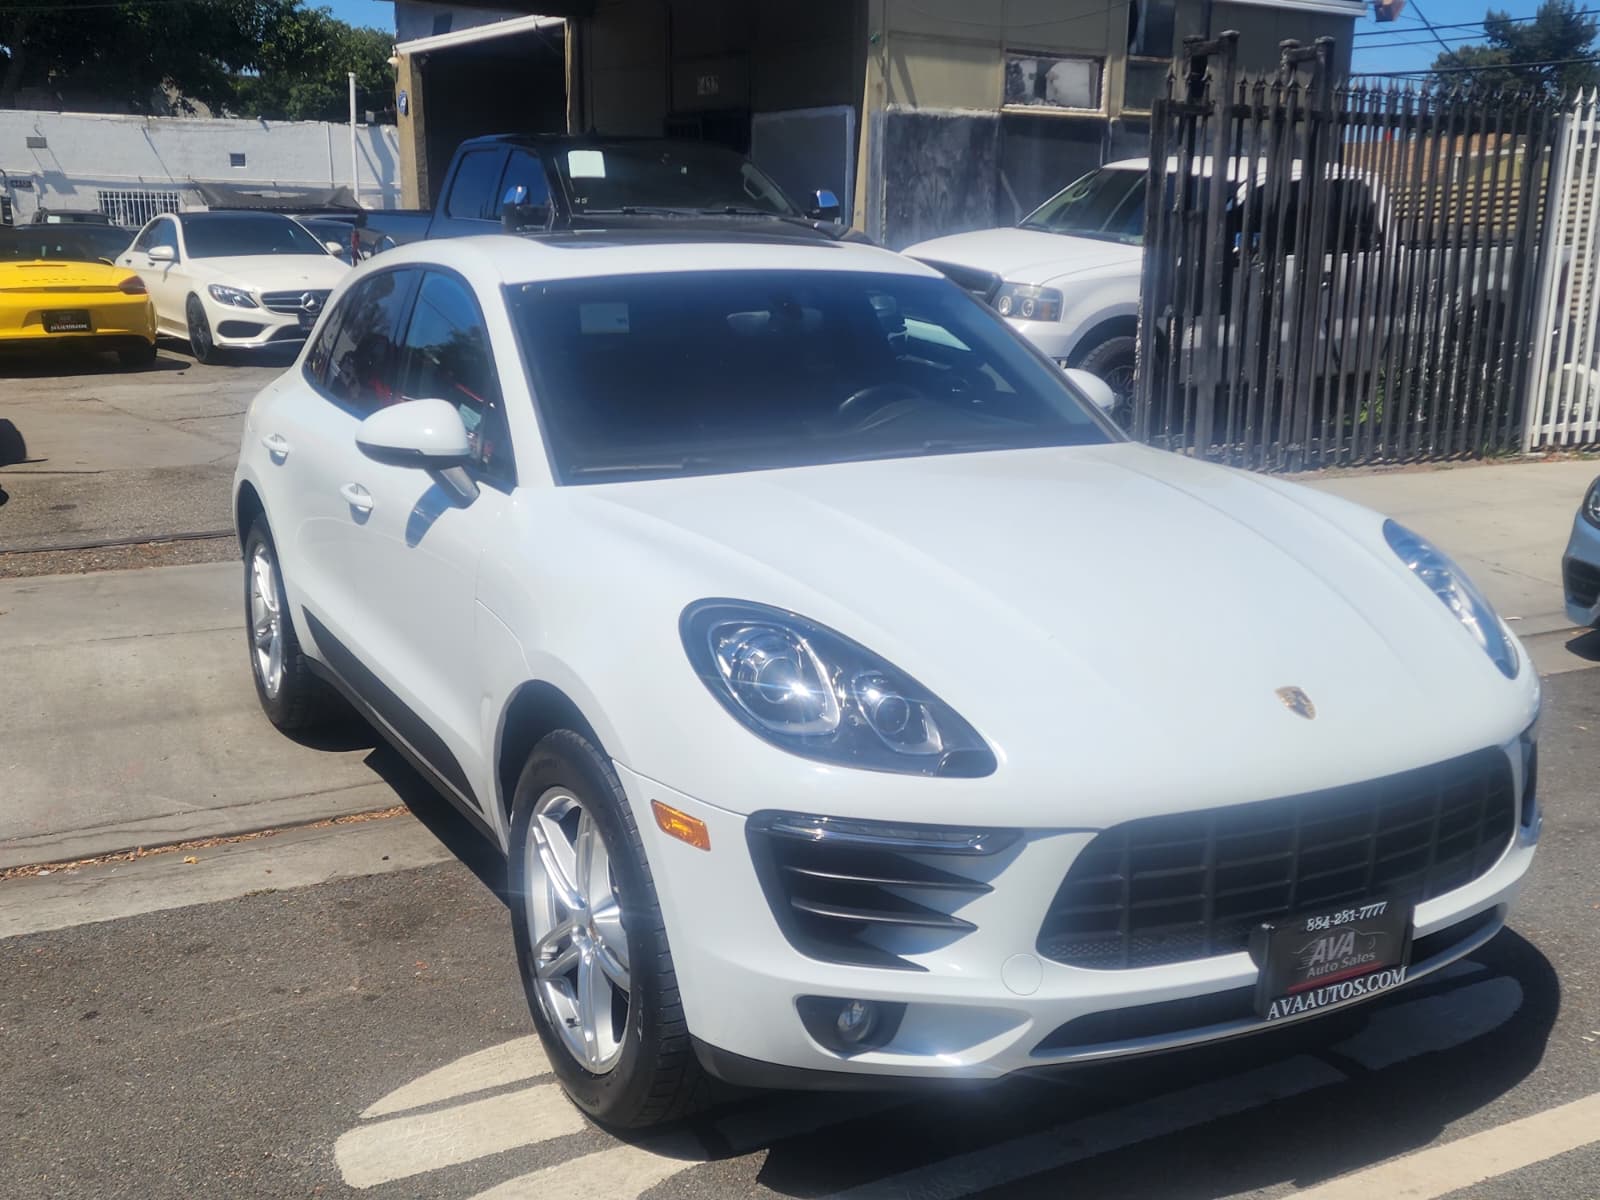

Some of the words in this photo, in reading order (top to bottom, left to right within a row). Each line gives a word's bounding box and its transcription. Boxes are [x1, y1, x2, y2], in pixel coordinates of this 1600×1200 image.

[1307, 961, 1339, 978] Auto
[1341, 951, 1376, 969] Sales
[1309, 932, 1355, 967] AVA
[1266, 966, 1408, 1020] AVAAUTOS.COM
